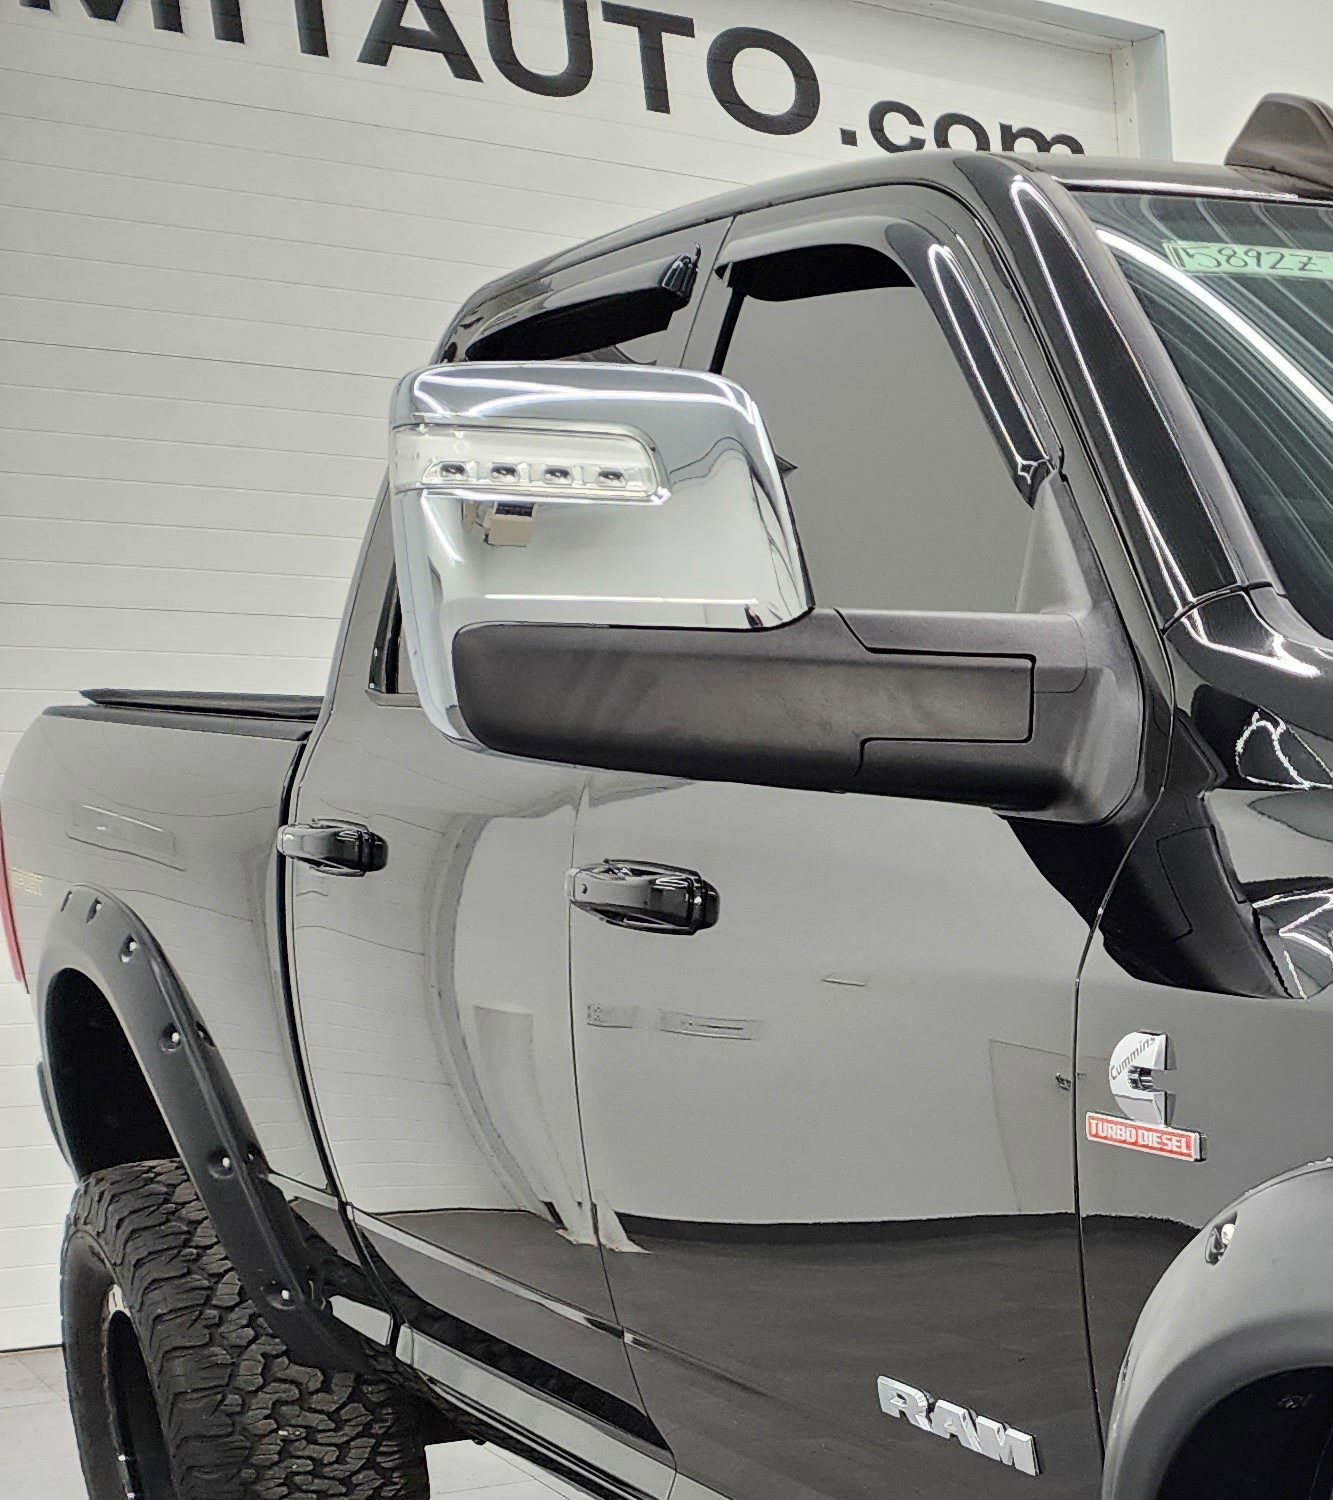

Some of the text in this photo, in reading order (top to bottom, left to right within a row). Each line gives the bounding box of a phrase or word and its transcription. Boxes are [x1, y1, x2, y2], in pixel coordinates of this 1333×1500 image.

[1110, 1036, 1156, 1081] Cummins
[1088, 1119, 1193, 1152] TURBO DIESEL
[877, 1375, 1041, 1477] RAM
